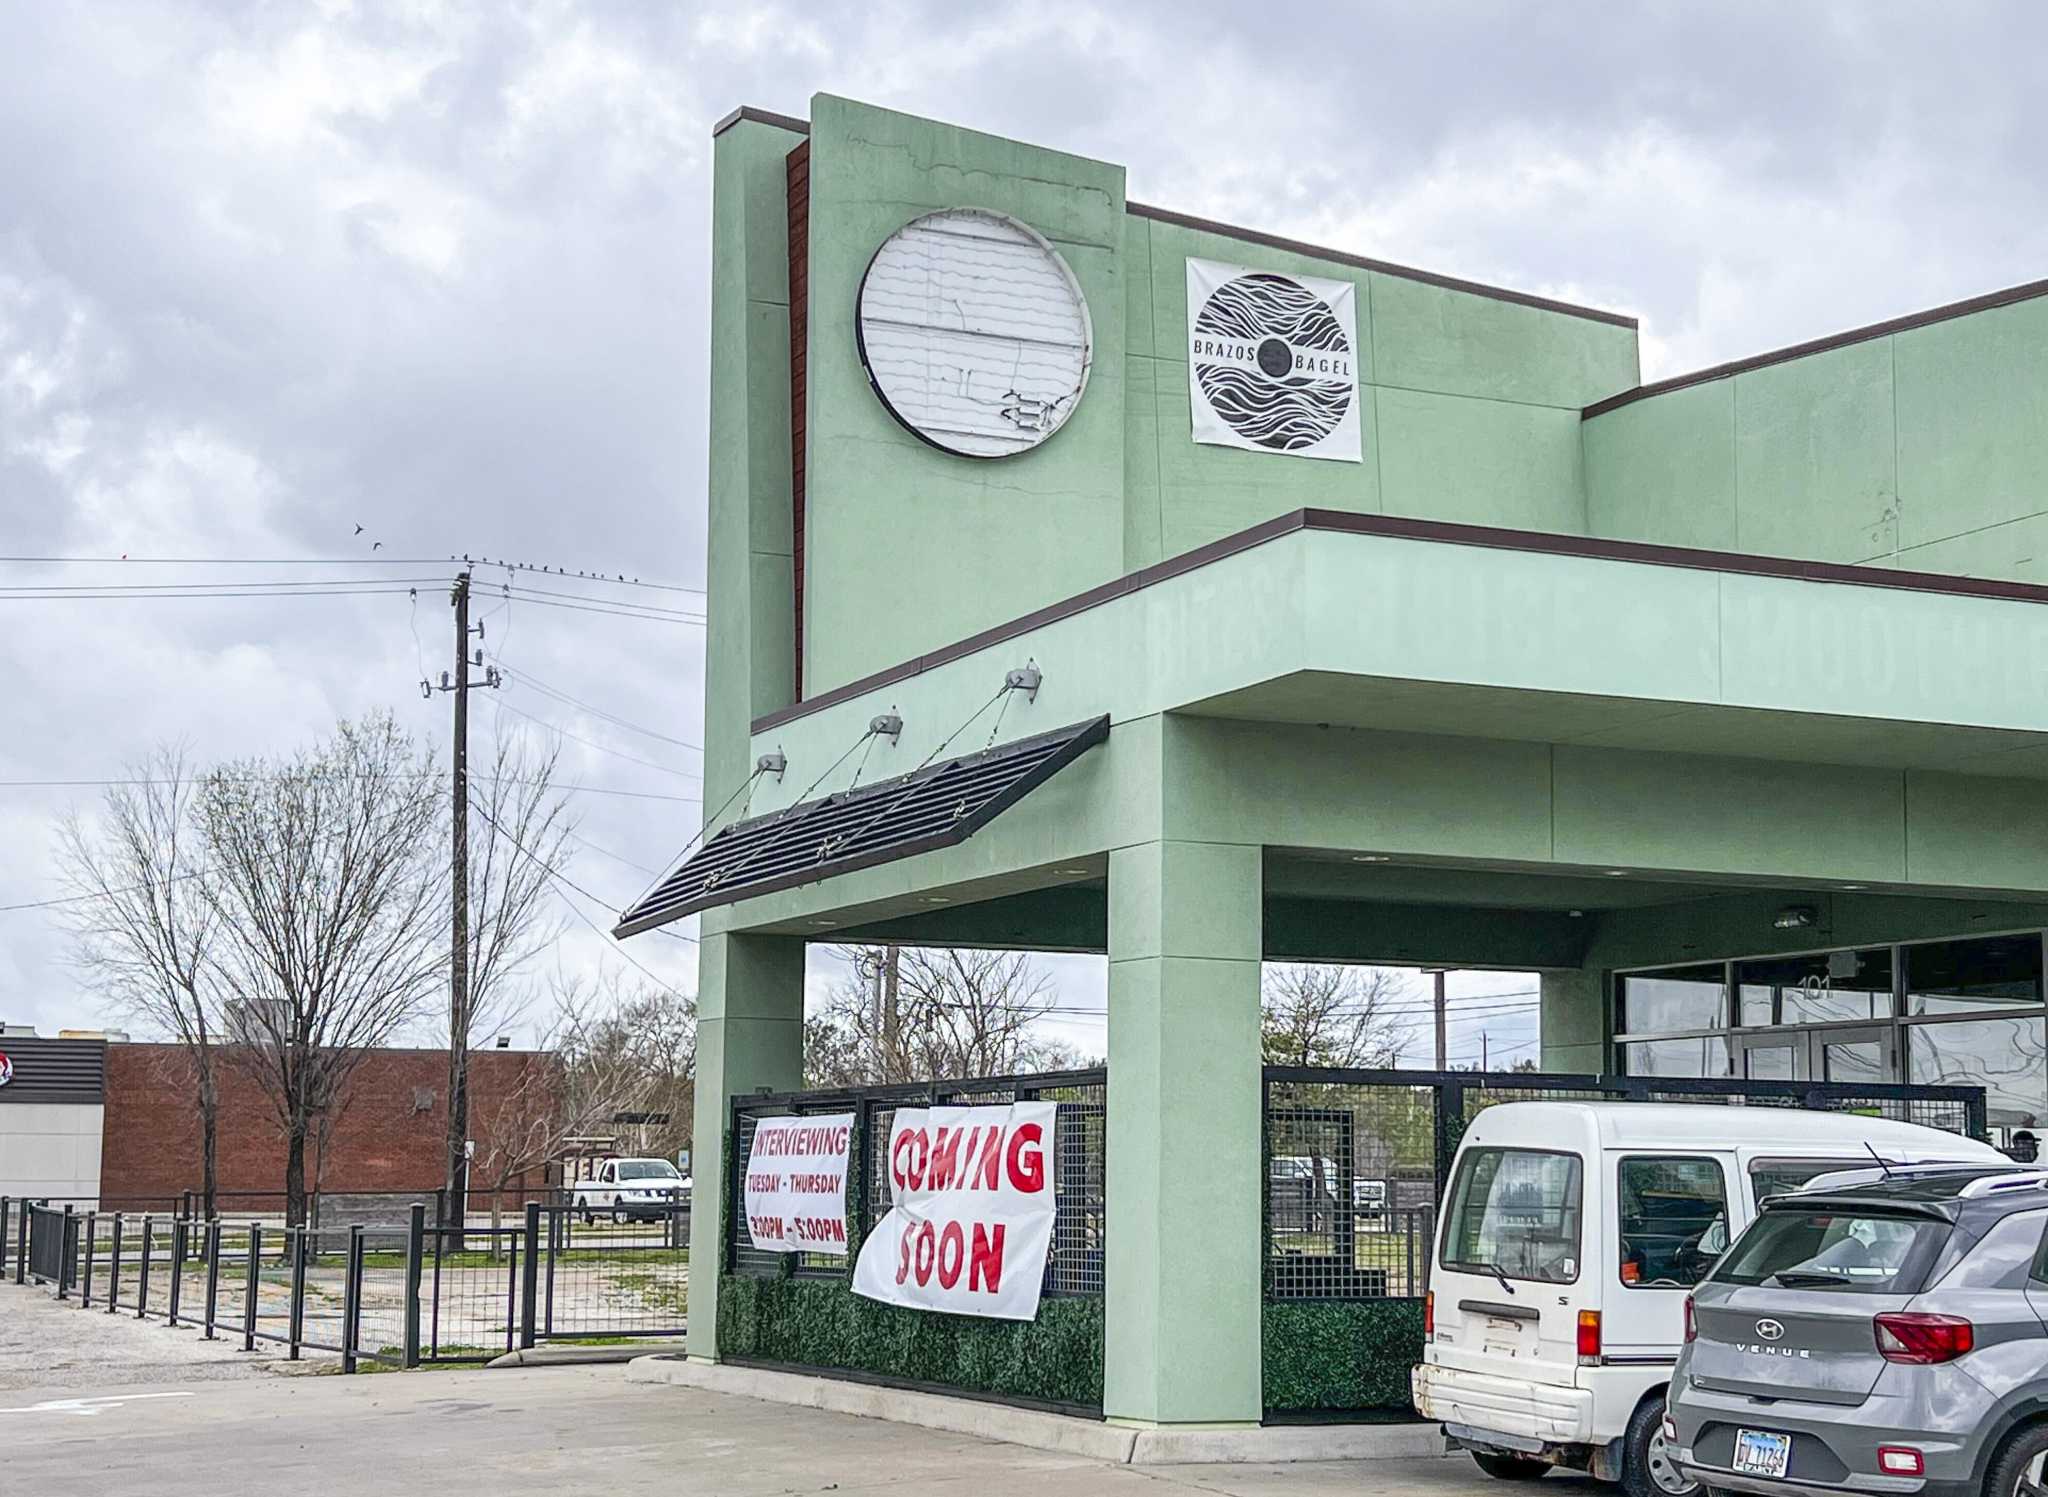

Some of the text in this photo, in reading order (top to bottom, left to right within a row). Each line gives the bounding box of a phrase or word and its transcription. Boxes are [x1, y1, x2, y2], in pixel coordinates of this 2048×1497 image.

[1194, 339, 1350, 376] BRAZOS BAGEL
[1797, 974, 1830, 1000] 101
[753, 1126, 848, 1157] INTERVIEWING
[893, 1123, 1044, 1194] COMING
[748, 1174, 781, 1193] TUESDAY
[789, 1173, 841, 1194] THURSDAY
[794, 1217, 845, 1242] 5:00PM
[895, 1219, 1006, 1294] SOON
[1736, 1343, 1810, 1359] VENUE
